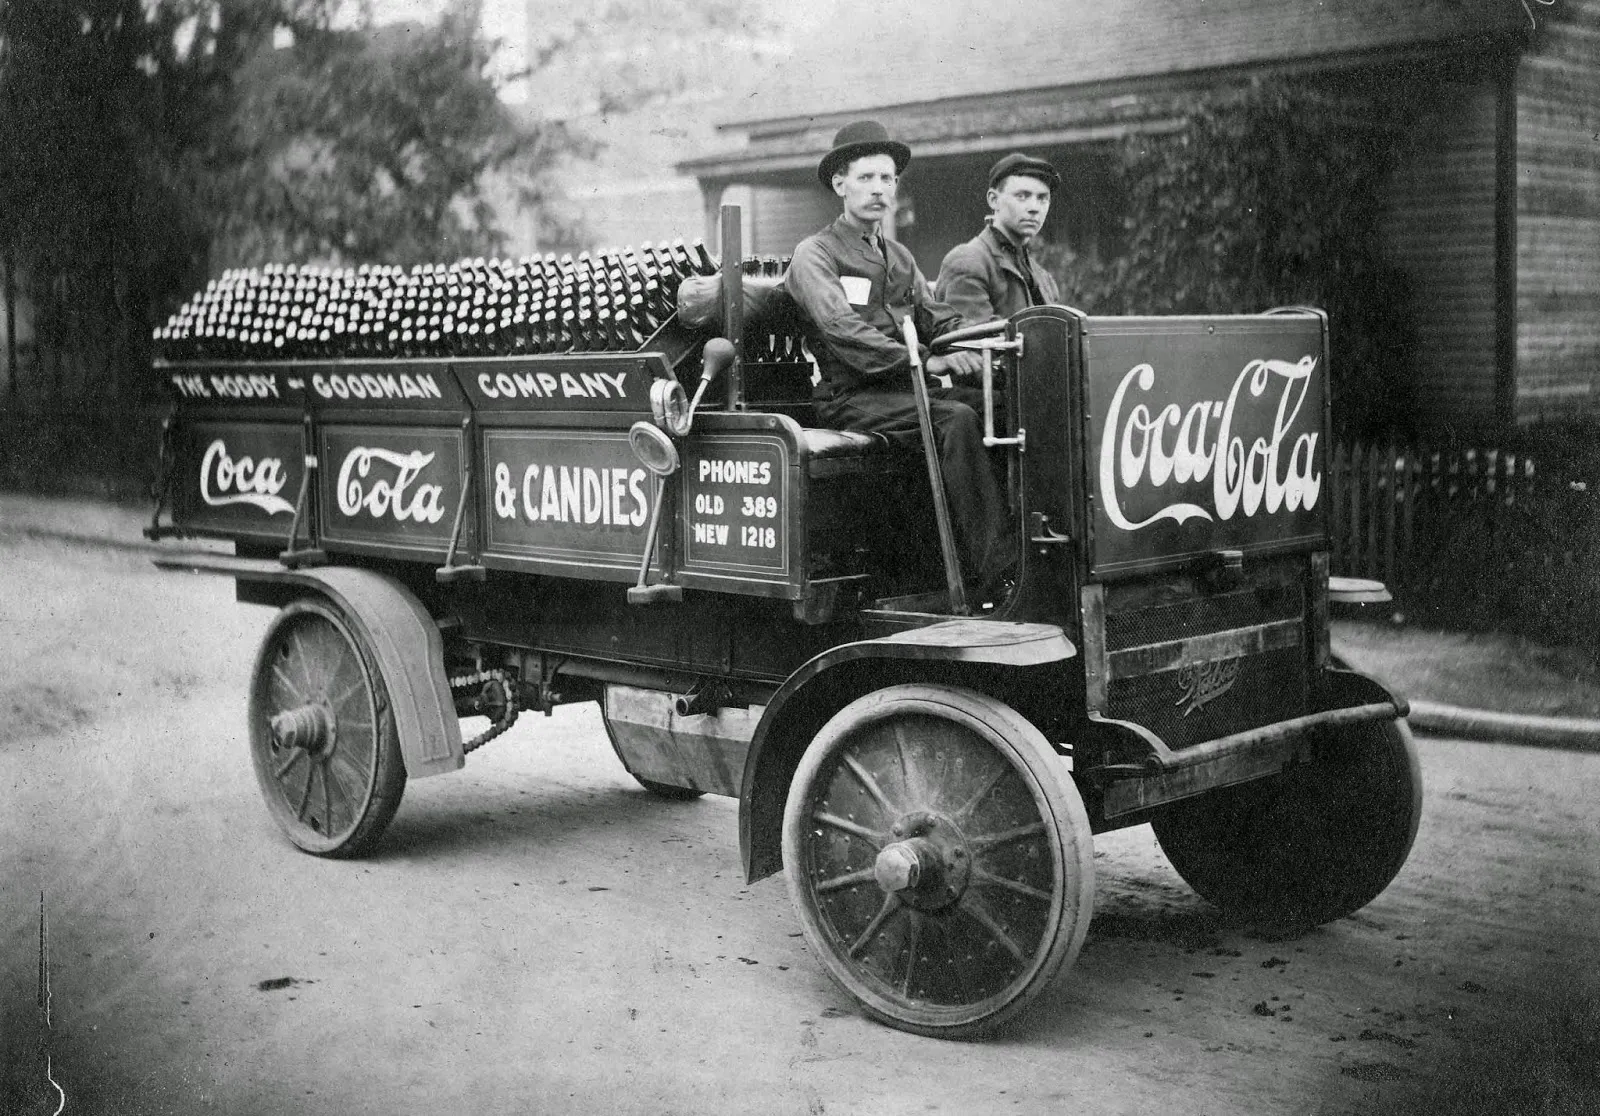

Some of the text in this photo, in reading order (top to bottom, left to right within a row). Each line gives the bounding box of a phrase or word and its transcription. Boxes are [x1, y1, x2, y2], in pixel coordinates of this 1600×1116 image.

[172, 374, 211, 398] THE
[210, 374, 280, 398] RODDY
[312, 373, 442, 399] GOODMAN
[477, 372, 627, 398] COMPANY
[200, 439, 648, 527] Coca Cola & CANDIES
[699, 459, 771, 485] PHONES
[695, 494, 778, 518] OLD 389
[695, 523, 776, 549] NEW 1218
